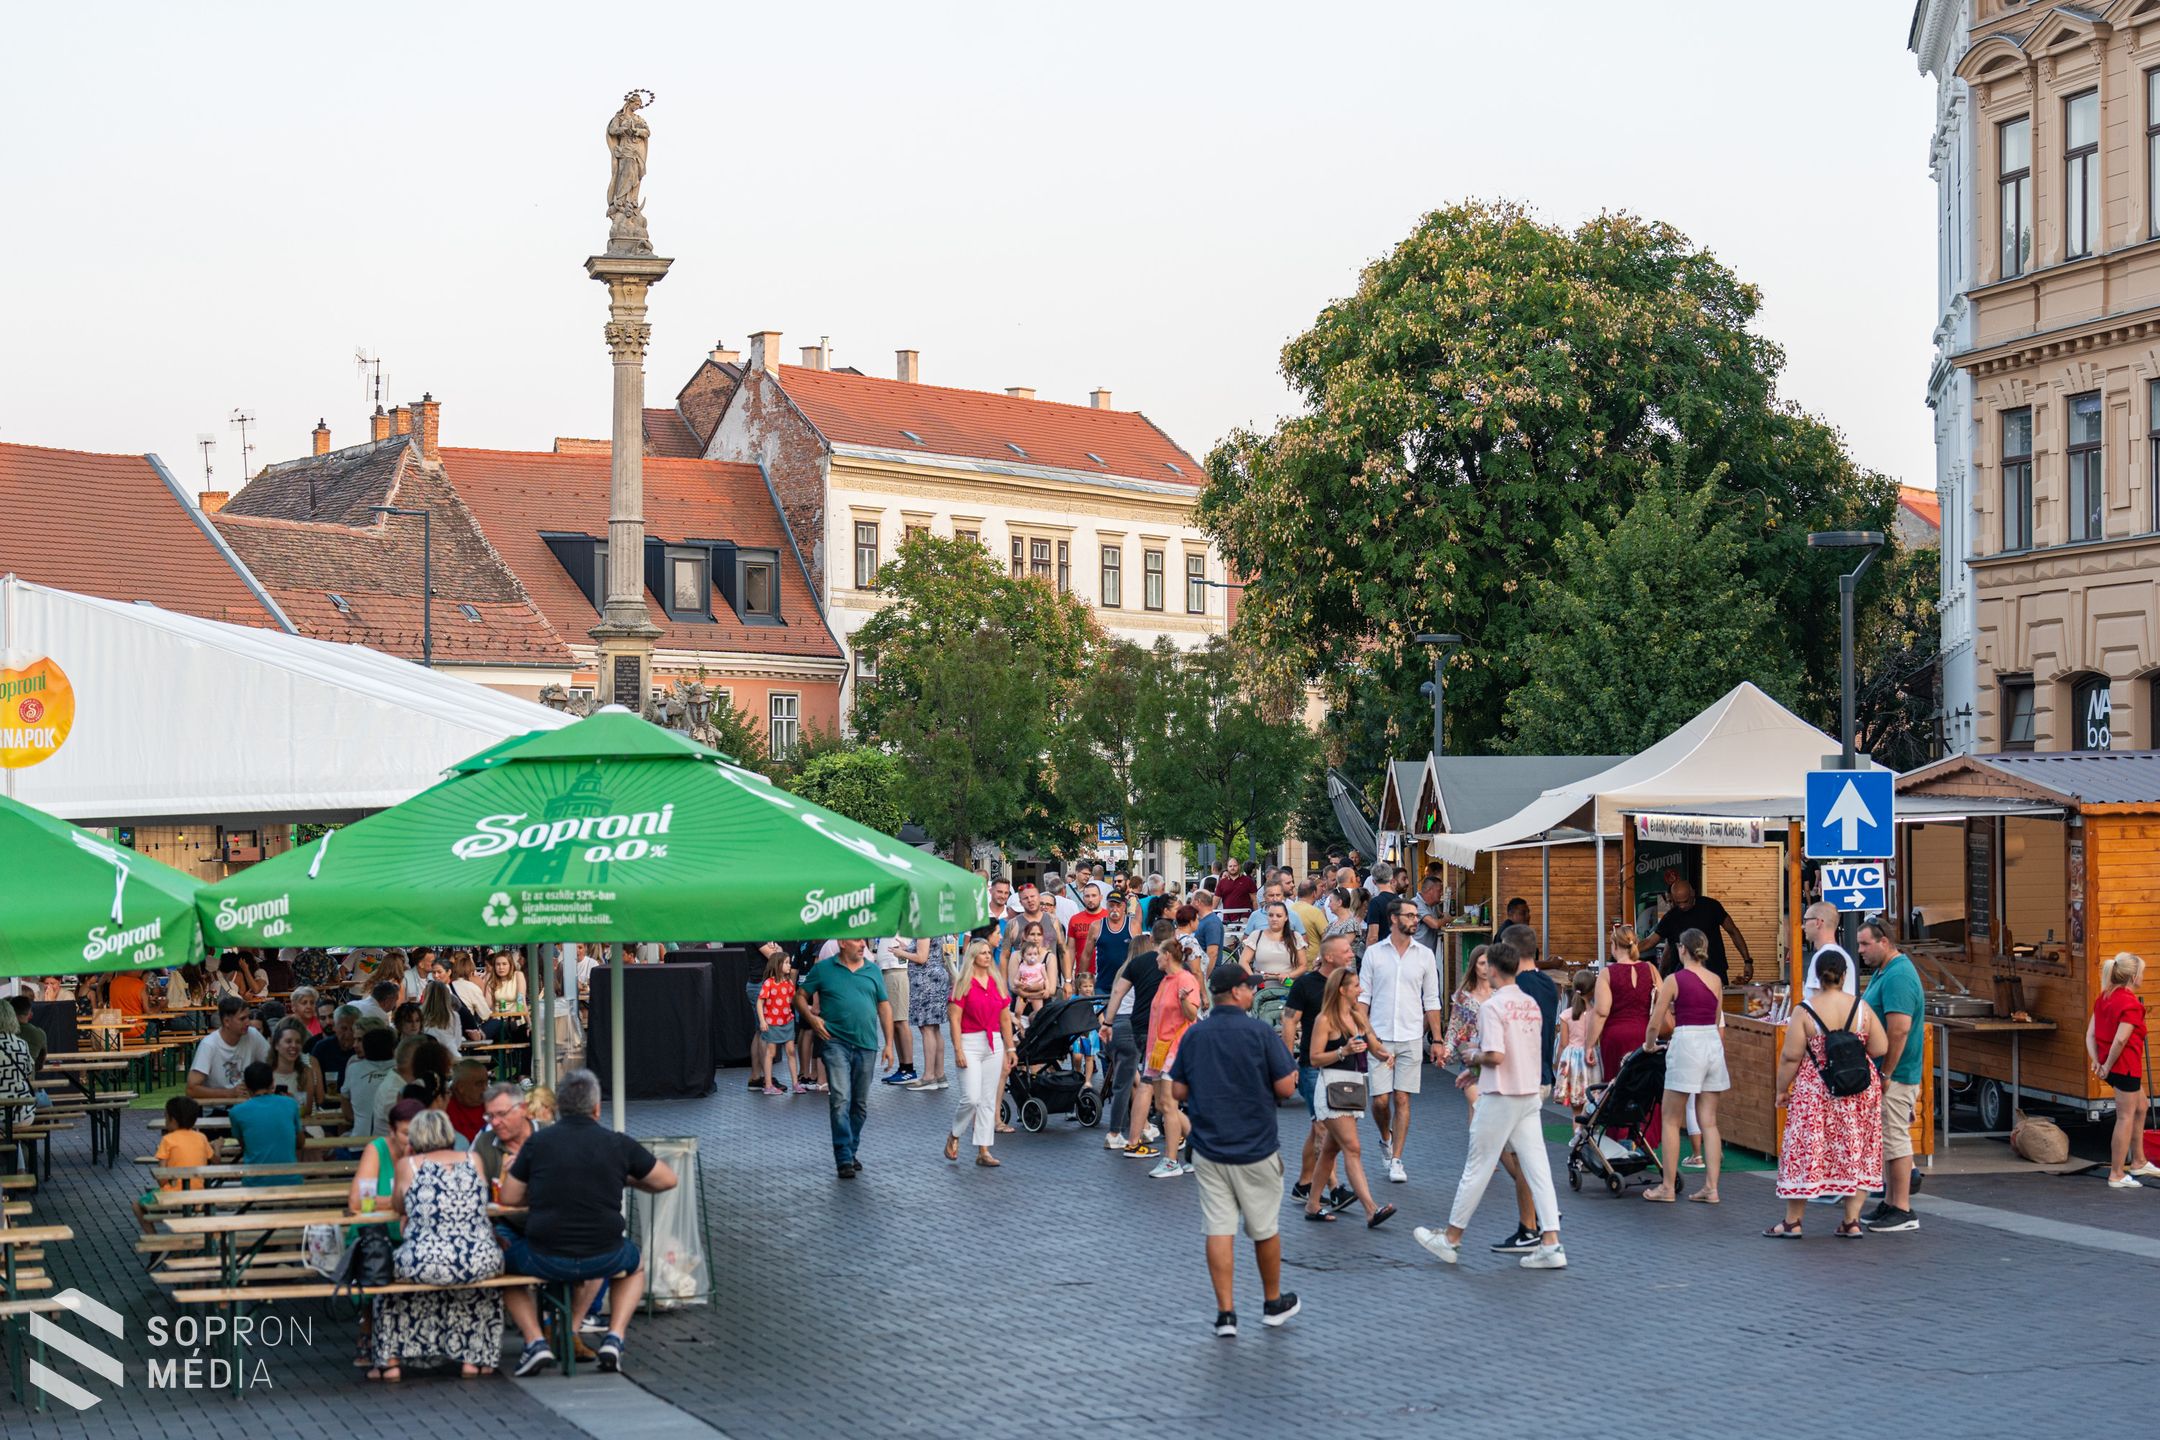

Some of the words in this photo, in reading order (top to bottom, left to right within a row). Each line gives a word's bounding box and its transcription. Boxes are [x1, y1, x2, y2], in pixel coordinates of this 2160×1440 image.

[0, 670, 46, 703] oproni
[0, 727, 56, 749] NAPOK
[451, 803, 675, 861] Soproni
[1636, 850, 1682, 875] Soproni
[1826, 867, 1880, 887] WC
[521, 891, 532, 901] Ez
[533, 892, 543, 901] az
[522, 902, 593, 914] újrahasznosított
[800, 883, 875, 925] Soproni
[215, 893, 289, 932] Soproni
[82, 917, 162, 962] Soproni
